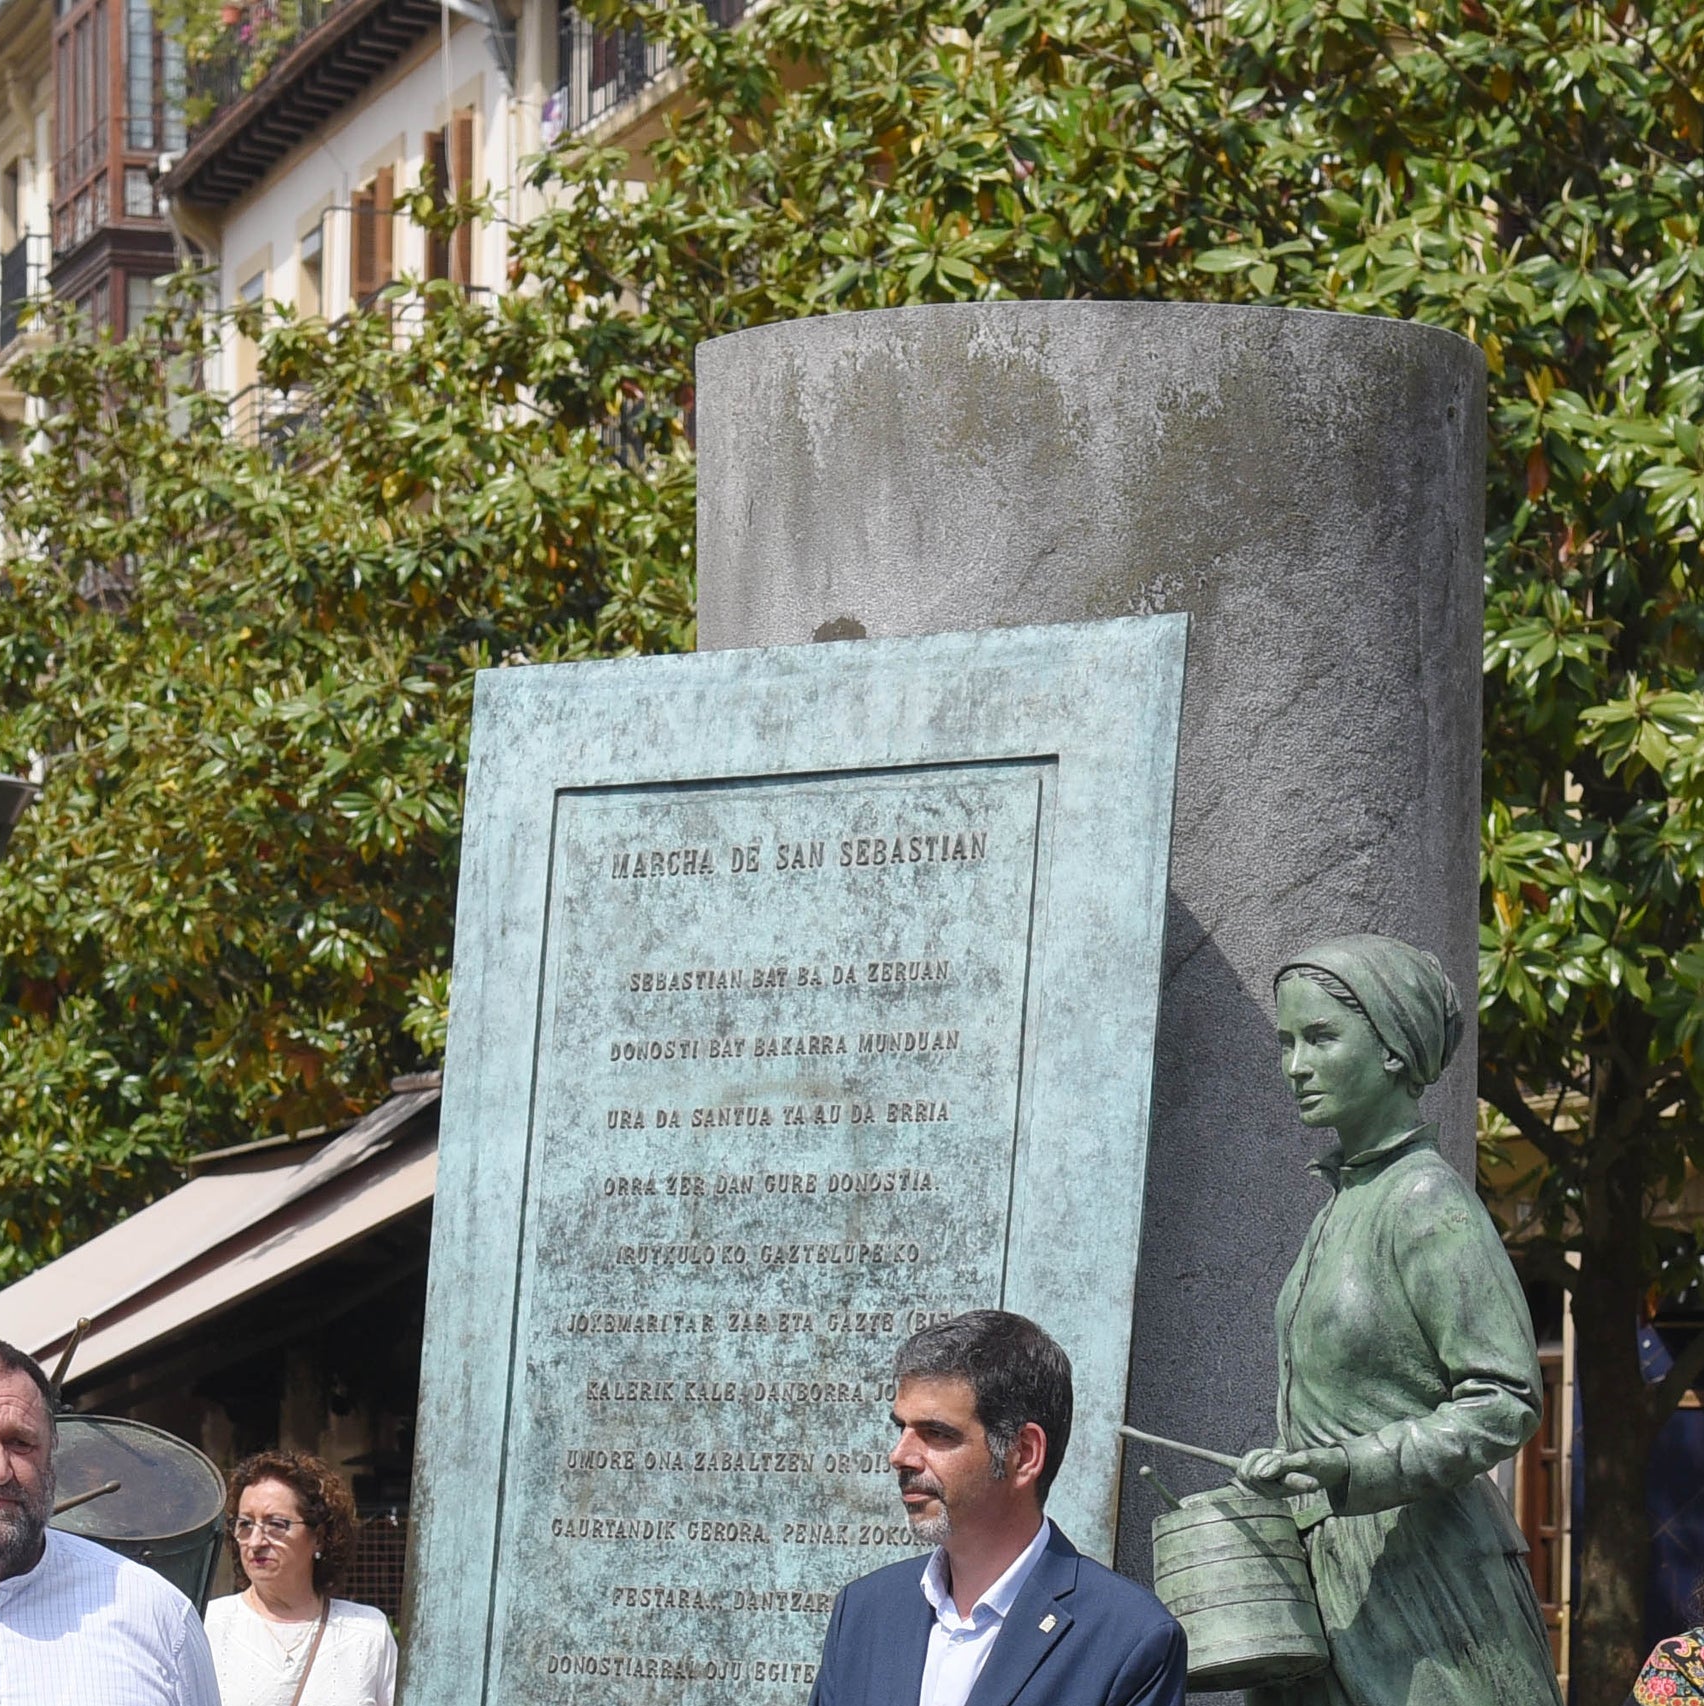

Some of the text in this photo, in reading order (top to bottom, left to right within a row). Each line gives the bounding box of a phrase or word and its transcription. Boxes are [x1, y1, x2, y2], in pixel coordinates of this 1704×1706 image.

[612, 849, 715, 879] MARCHA
[776, 841, 825, 871] SAN
[839, 832, 988, 868] SEBASTIAN
[630, 960, 950, 992] SEBASTIAN BAT BA DA ZERUAN
[610, 1030, 960, 1061] DONOSTI BAT BAKARRA MUNDUAN
[607, 1100, 950, 1129] URA DA SANTUA TA AU DA ERRIA
[604, 1175, 656, 1196] ORRA
[666, 1174, 705, 1196] ZER
[716, 1173, 753, 1195] DAN
[765, 1172, 817, 1194] GURE
[727, 1312, 768, 1333] ZAR
[778, 1312, 814, 1332] ETA
[827, 1311, 894, 1333] GAZTE
[586, 1381, 674, 1401] KALERIK
[754, 1381, 863, 1402] DANBORRA
[567, 1450, 634, 1470] UMORE
[645, 1450, 684, 1471] ONA
[694, 1452, 814, 1473] ZABALTZEN
[551, 1518, 677, 1540] GAURTANDIK
[783, 1523, 848, 1545] PENAK
[734, 1591, 831, 1613] DANTZAR
[754, 1661, 815, 1683] EGITE
